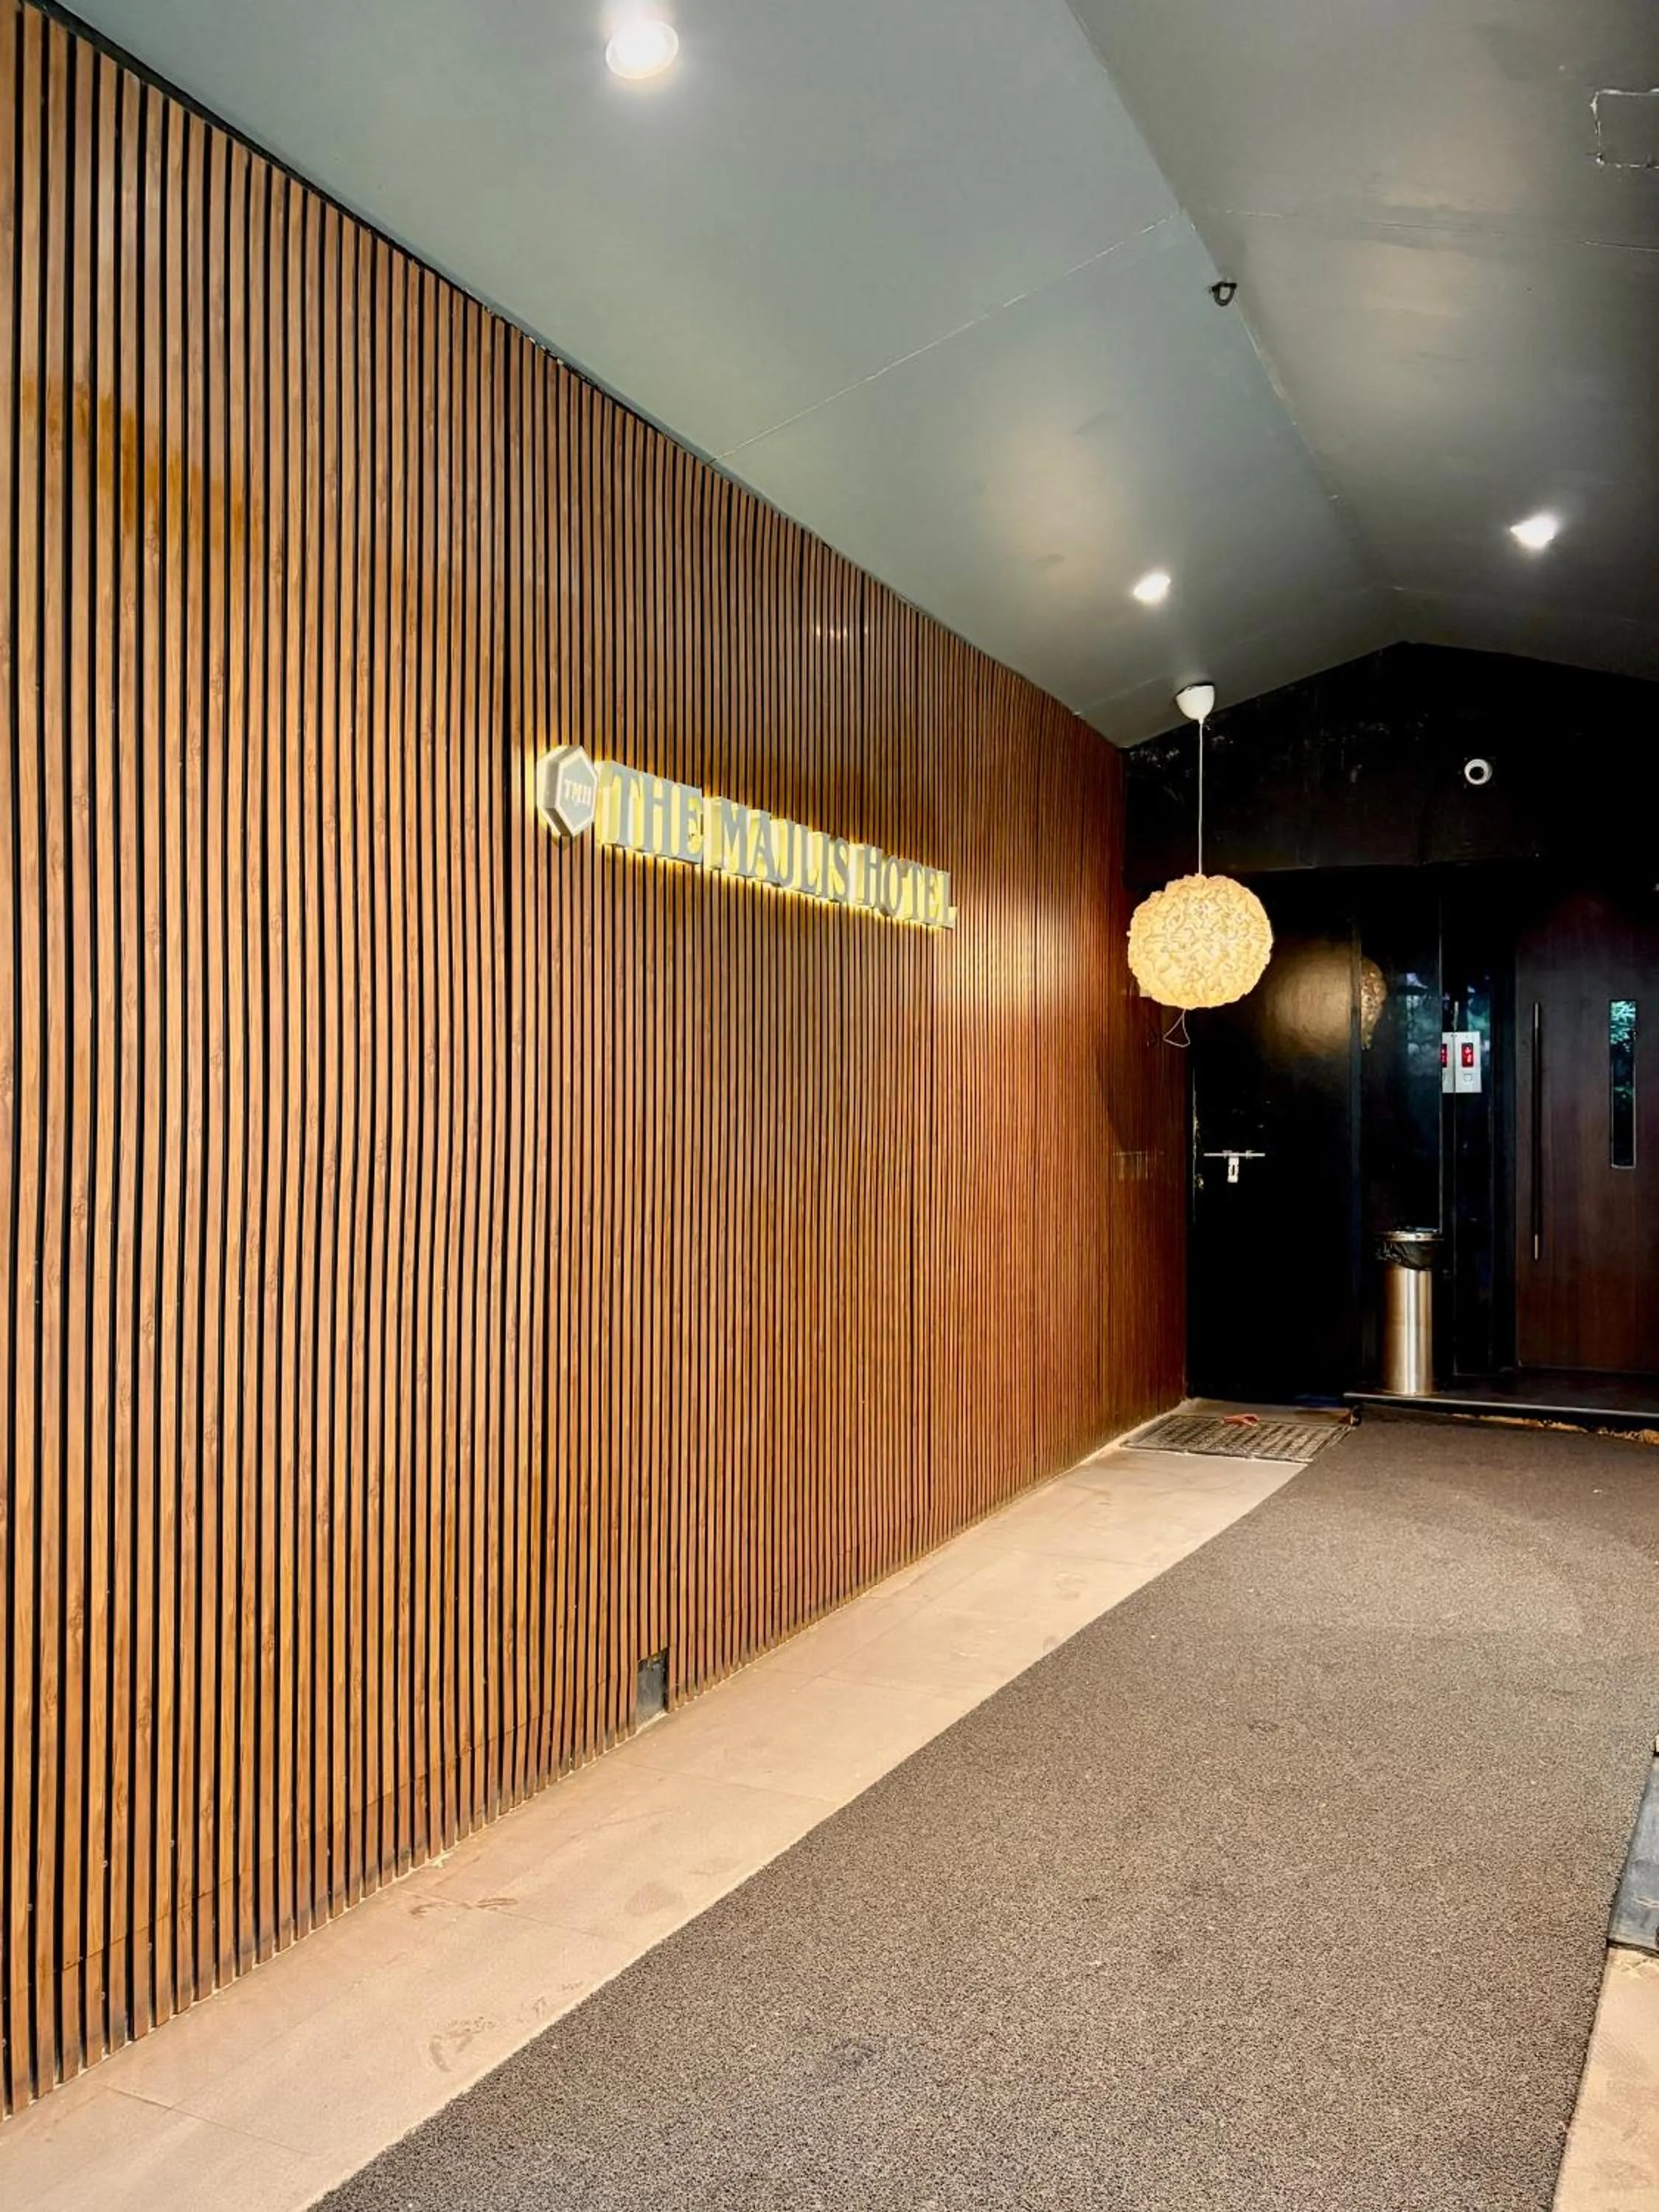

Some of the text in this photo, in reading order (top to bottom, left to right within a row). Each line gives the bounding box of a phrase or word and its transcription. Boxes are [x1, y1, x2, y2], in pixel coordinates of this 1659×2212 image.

[601, 761, 955, 929] THE MAJLIS HOTEL
